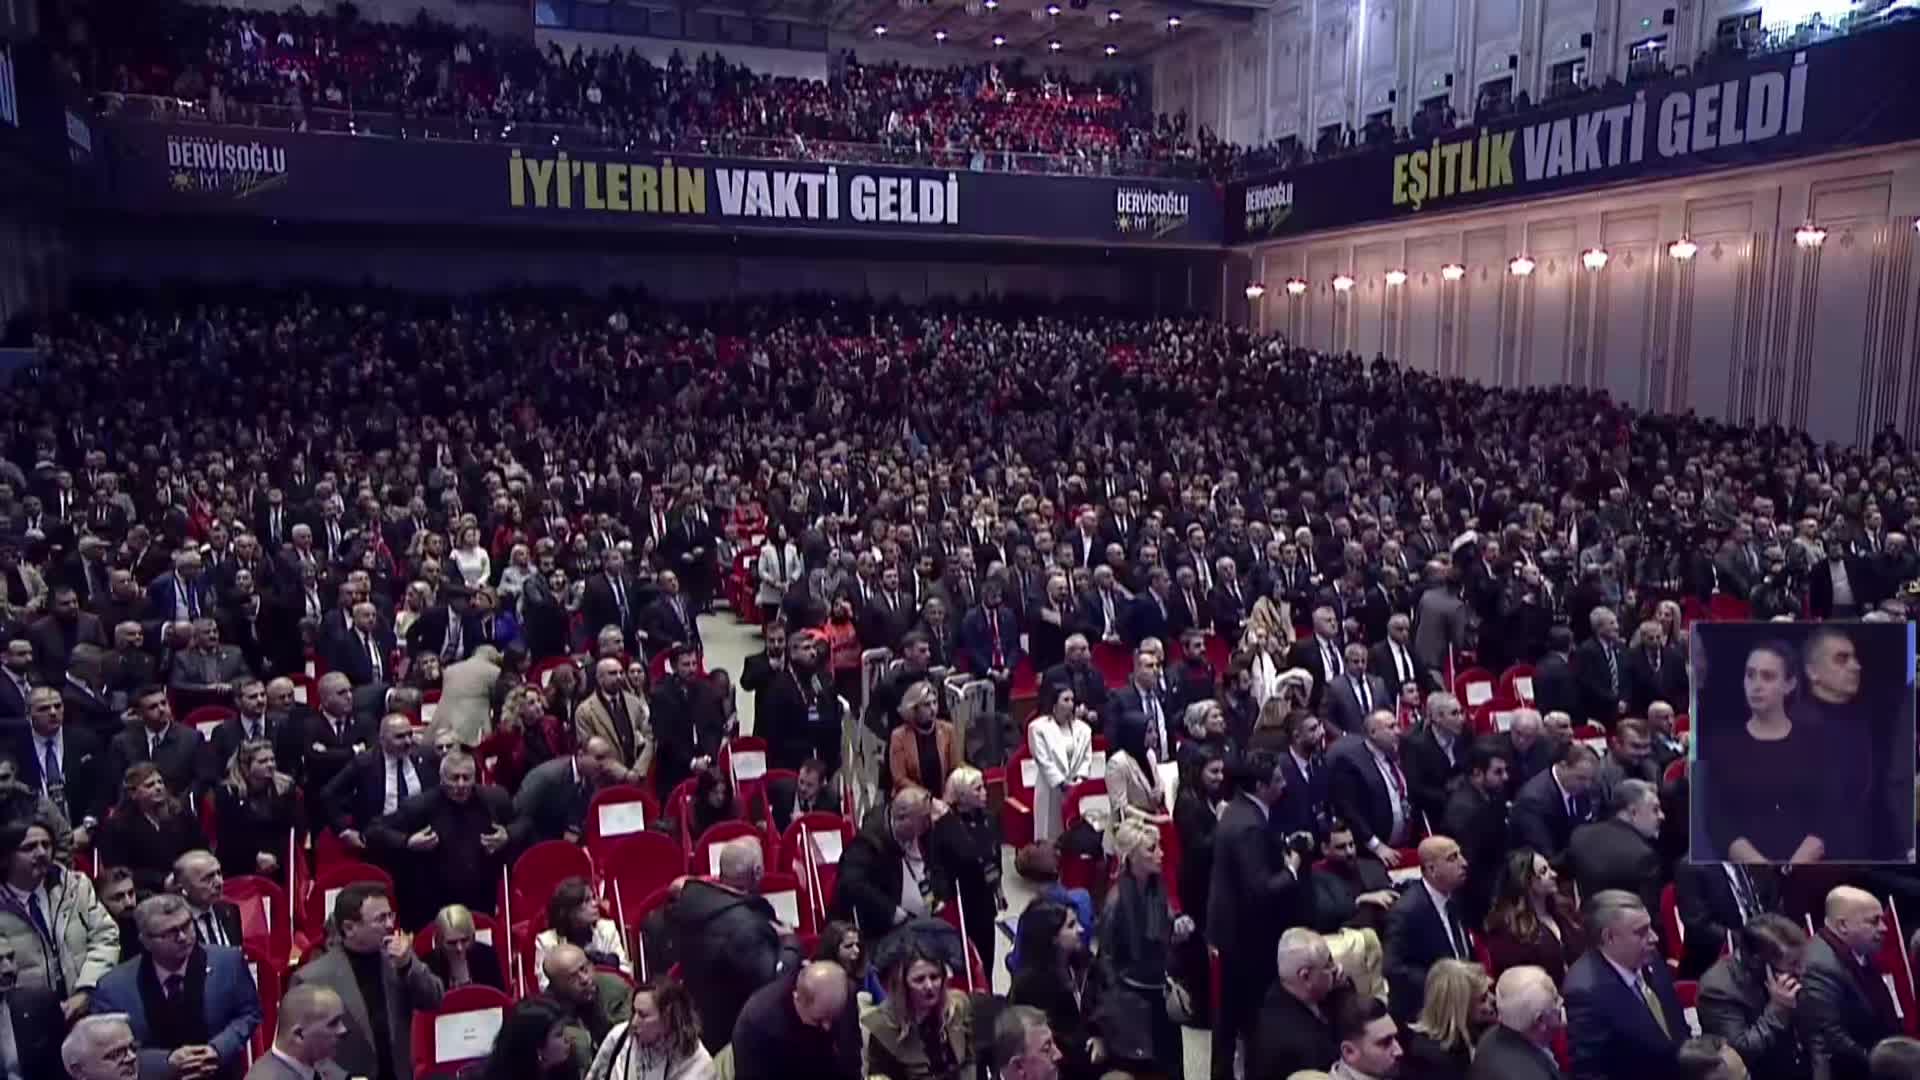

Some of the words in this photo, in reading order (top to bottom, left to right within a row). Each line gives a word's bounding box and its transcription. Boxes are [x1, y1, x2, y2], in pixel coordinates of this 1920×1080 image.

[1393, 127, 1516, 210] EŞİTLİK
[1523, 90, 1647, 181] VAKTİ
[1656, 52, 1808, 158] GELDİ
[168, 139, 286, 174] DERVİŞOĞLU
[509, 149, 706, 214] İYİ'LERİN
[715, 166, 839, 219] VAKTİ
[850, 172, 959, 224] GELDİ
[1117, 189, 1189, 217] DERVİŞOĞLU
[1245, 181, 1294, 213] DERVİŞOĞLU
